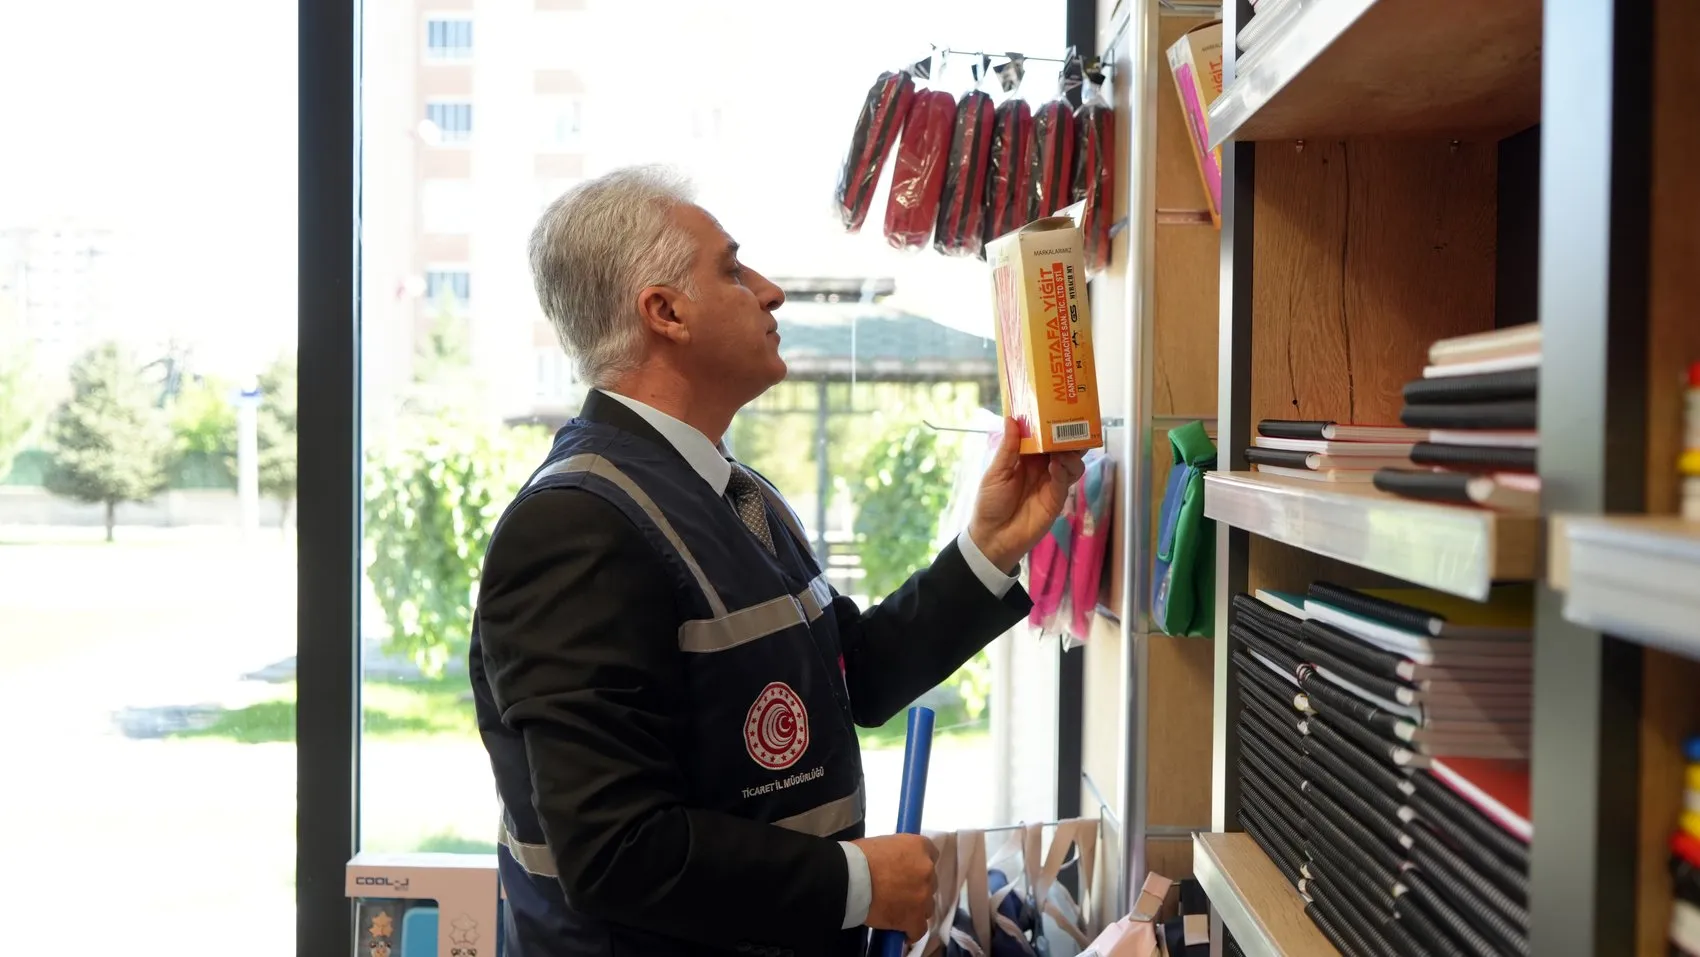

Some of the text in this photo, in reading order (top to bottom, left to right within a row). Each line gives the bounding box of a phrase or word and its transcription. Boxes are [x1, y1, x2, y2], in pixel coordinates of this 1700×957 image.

[1038, 268, 1055, 312] YİĞİT
[1057, 284, 1065, 298] LTD.
[1060, 314, 1068, 330] SAN.
[1046, 317, 1067, 402] MUSTAFA
[1061, 332, 1072, 367] SARACİYE
[1068, 374, 1077, 398] ÇANTA
[741, 766, 825, 798] TİCARET İL MÜDÜRLÜĞÜ
[356, 876, 409, 886] COOL-J
